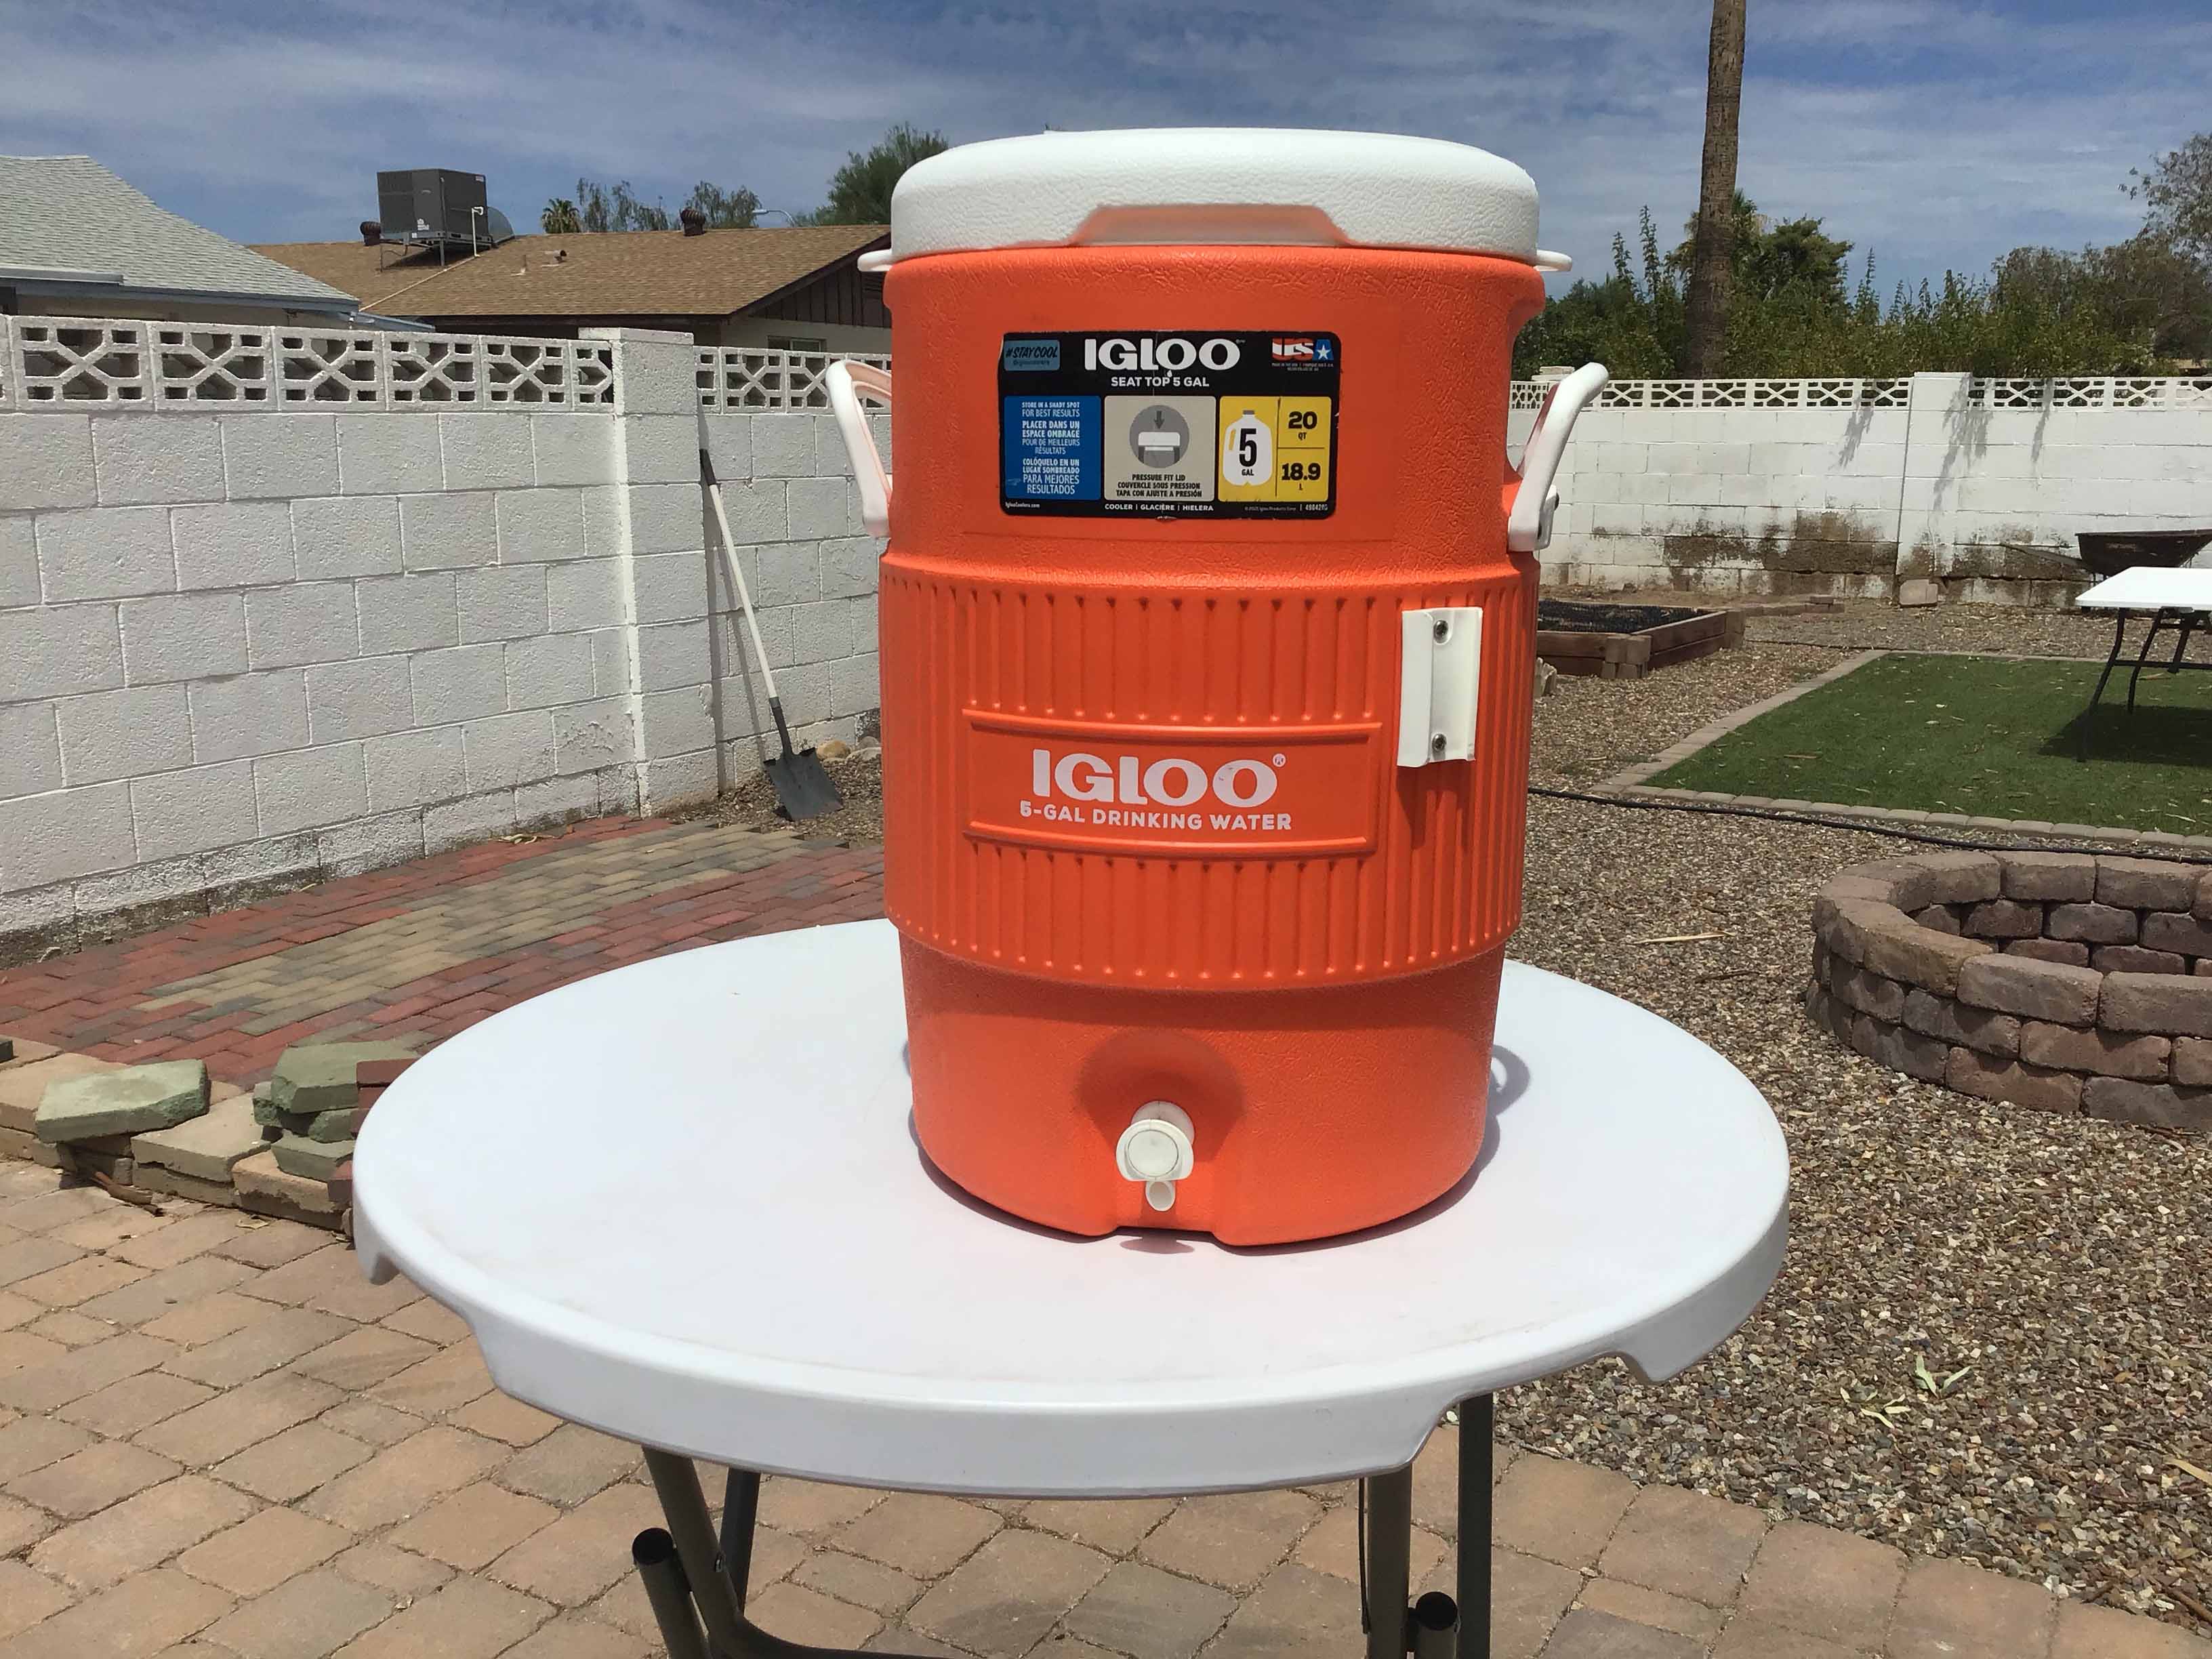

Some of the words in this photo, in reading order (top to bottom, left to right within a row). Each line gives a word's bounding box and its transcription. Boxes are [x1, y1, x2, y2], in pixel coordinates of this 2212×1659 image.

[1084, 337, 1241, 371] IGLOO
[1272, 337, 1334, 361] USA
[1111, 377, 1142, 387] SEAT
[1145, 377, 1170, 387] TOP
[1173, 377, 1181, 387] 5
[1183, 377, 1210, 387] GAL
[1022, 421, 1047, 429] PLACER
[1049, 421, 1067, 429] DANS
[1069, 421, 1080, 429] UN
[1288, 411, 1317, 429] 20
[1022, 430, 1045, 438] ESPACE
[1298, 432, 1307, 441] QT
[1035, 445, 1067, 454] RÉSULTATS
[1239, 428, 1257, 467] 5
[1023, 456, 1059, 466] COLÓQUELO
[1282, 462, 1321, 480] 18.9
[1023, 474, 1042, 483] PARA
[1044, 474, 1080, 485] MEJORES
[1027, 484, 1076, 495] RESULTADOS
[1175, 489, 1202, 497] PRESIÓN
[1019, 800, 1086, 823] 5-GAL
[1092, 808, 1200, 830] DRINKING
[1209, 814, 1292, 830] WATER
